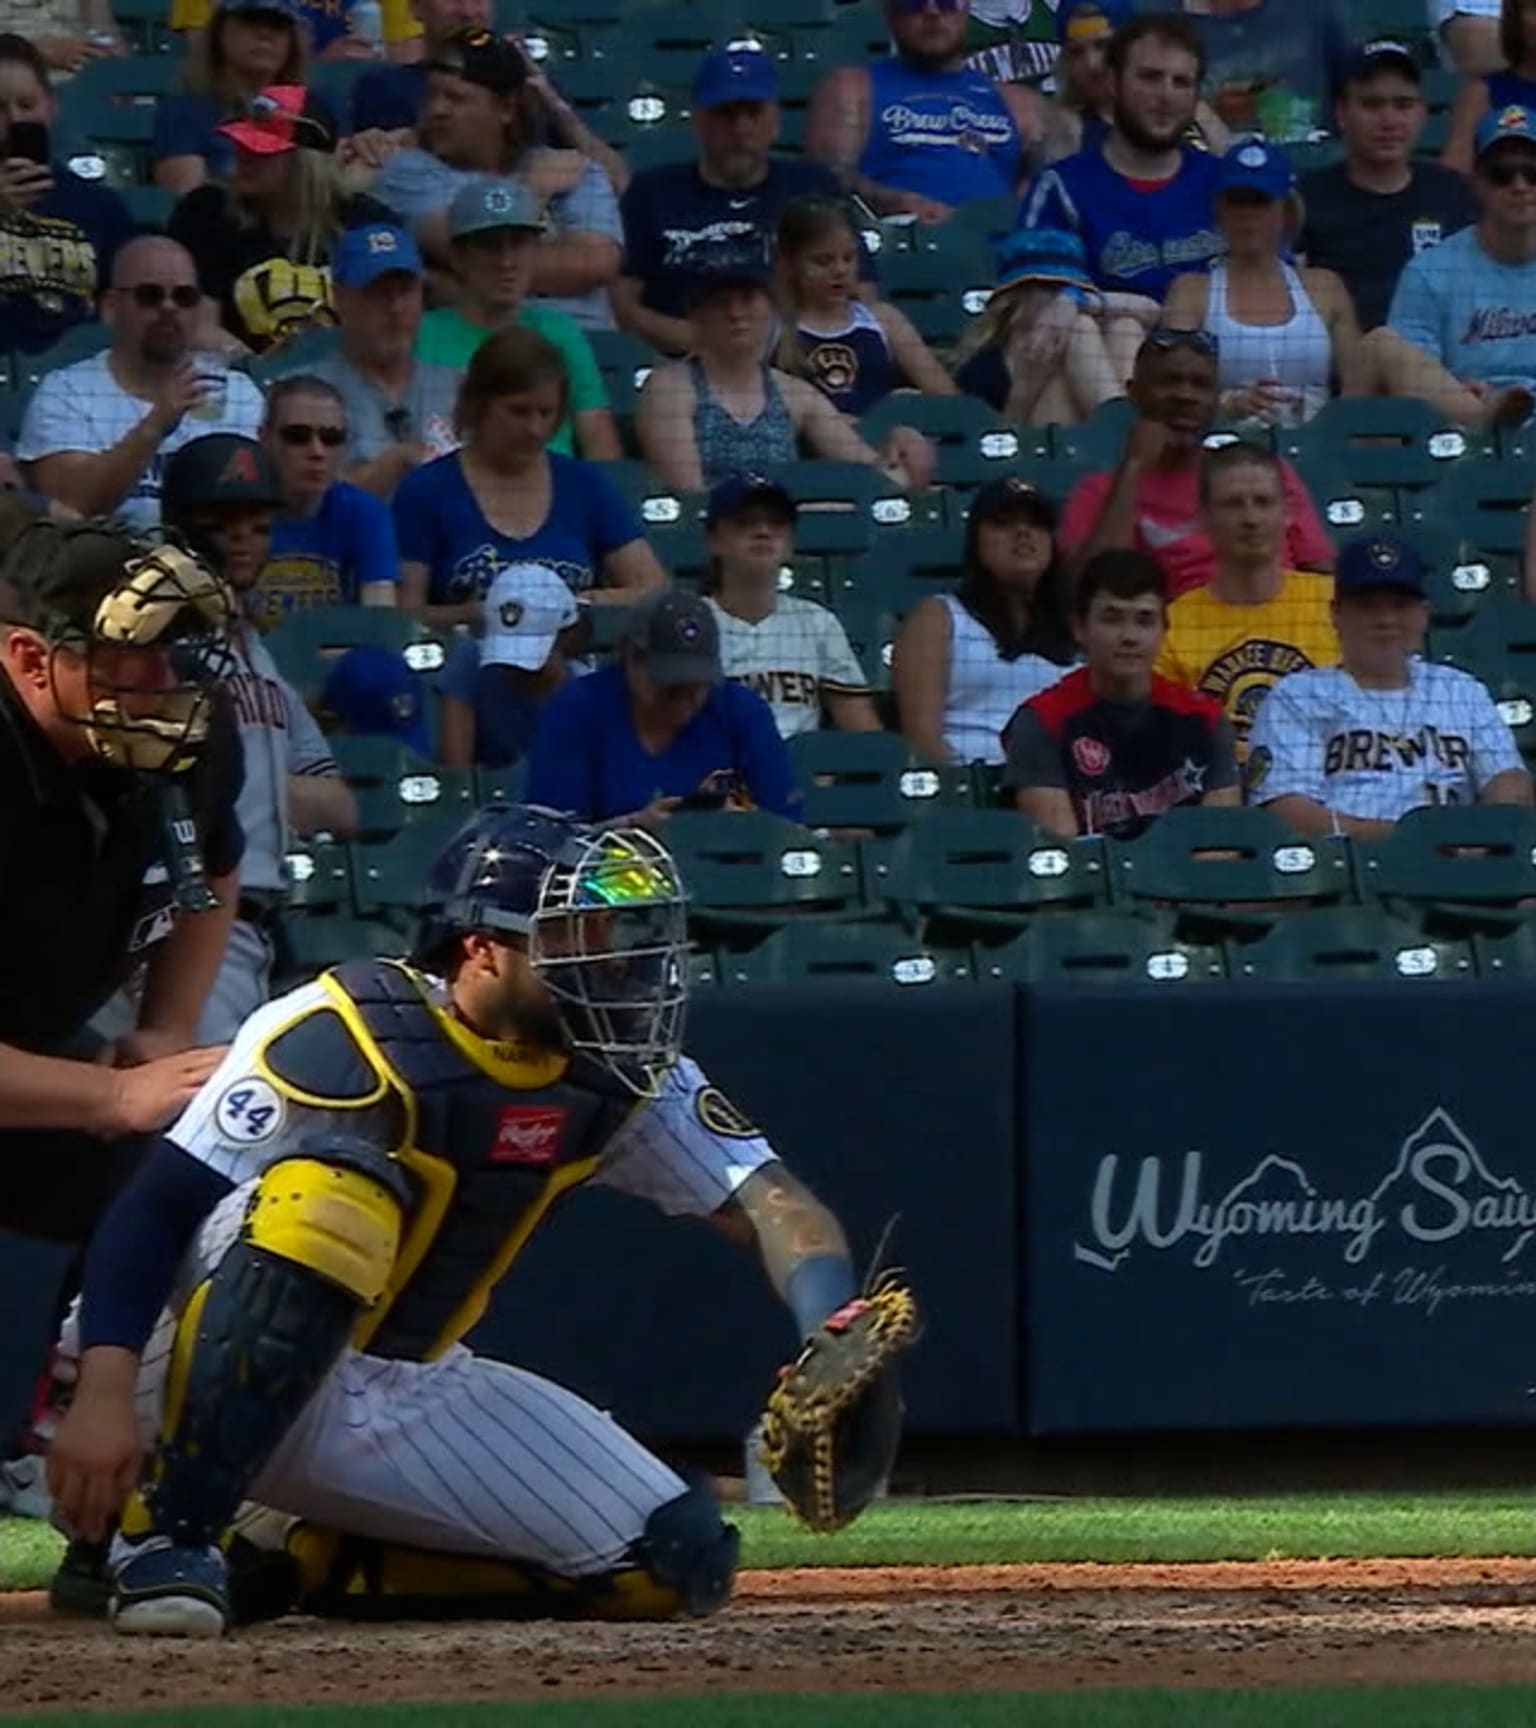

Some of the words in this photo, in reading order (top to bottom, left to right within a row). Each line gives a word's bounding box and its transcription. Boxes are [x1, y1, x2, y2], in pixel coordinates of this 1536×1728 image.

[883, 104, 948, 134] Brew
[949, 104, 1008, 133] Crew
[228, 1089, 276, 1136] 44
[1091, 1151, 1384, 1267] Wyoming
[1343, 1273, 1383, 1306] of
